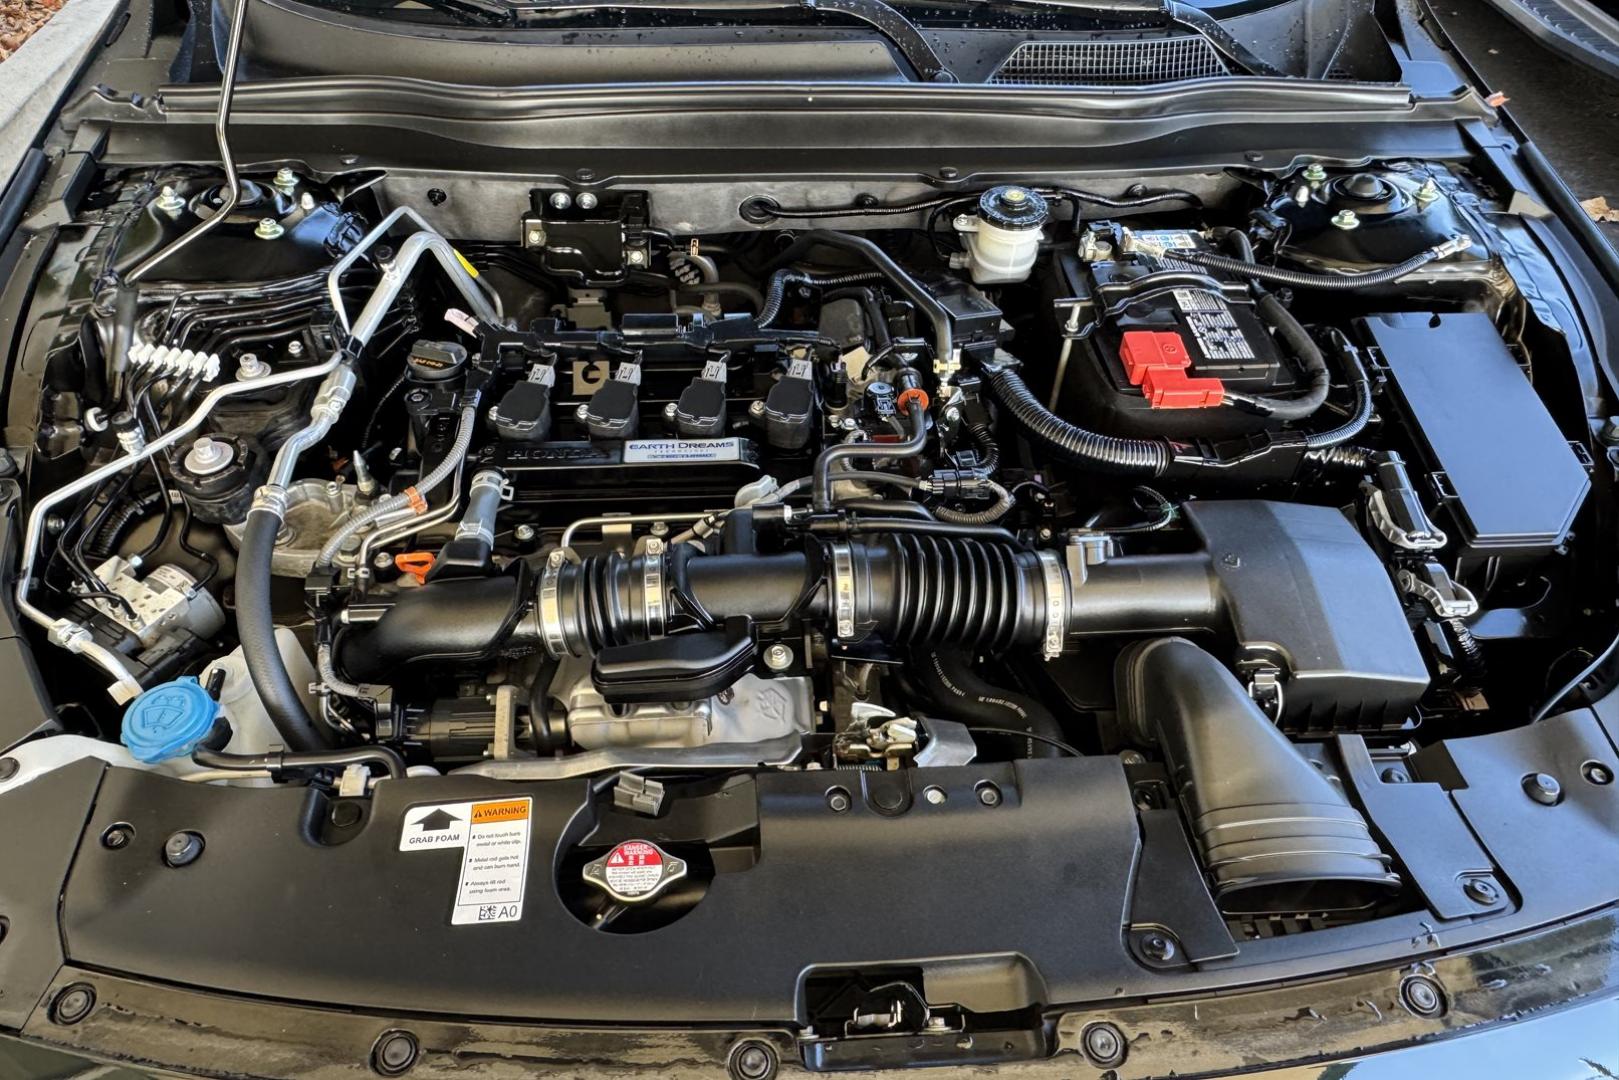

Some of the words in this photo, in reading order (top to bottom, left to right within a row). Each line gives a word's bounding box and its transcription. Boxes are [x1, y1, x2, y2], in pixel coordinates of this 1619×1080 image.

[484, 805, 527, 817] WARNING
[409, 835, 434, 844] GRAB
[435, 833, 460, 843] FOAM
[498, 904, 518, 919] A0
